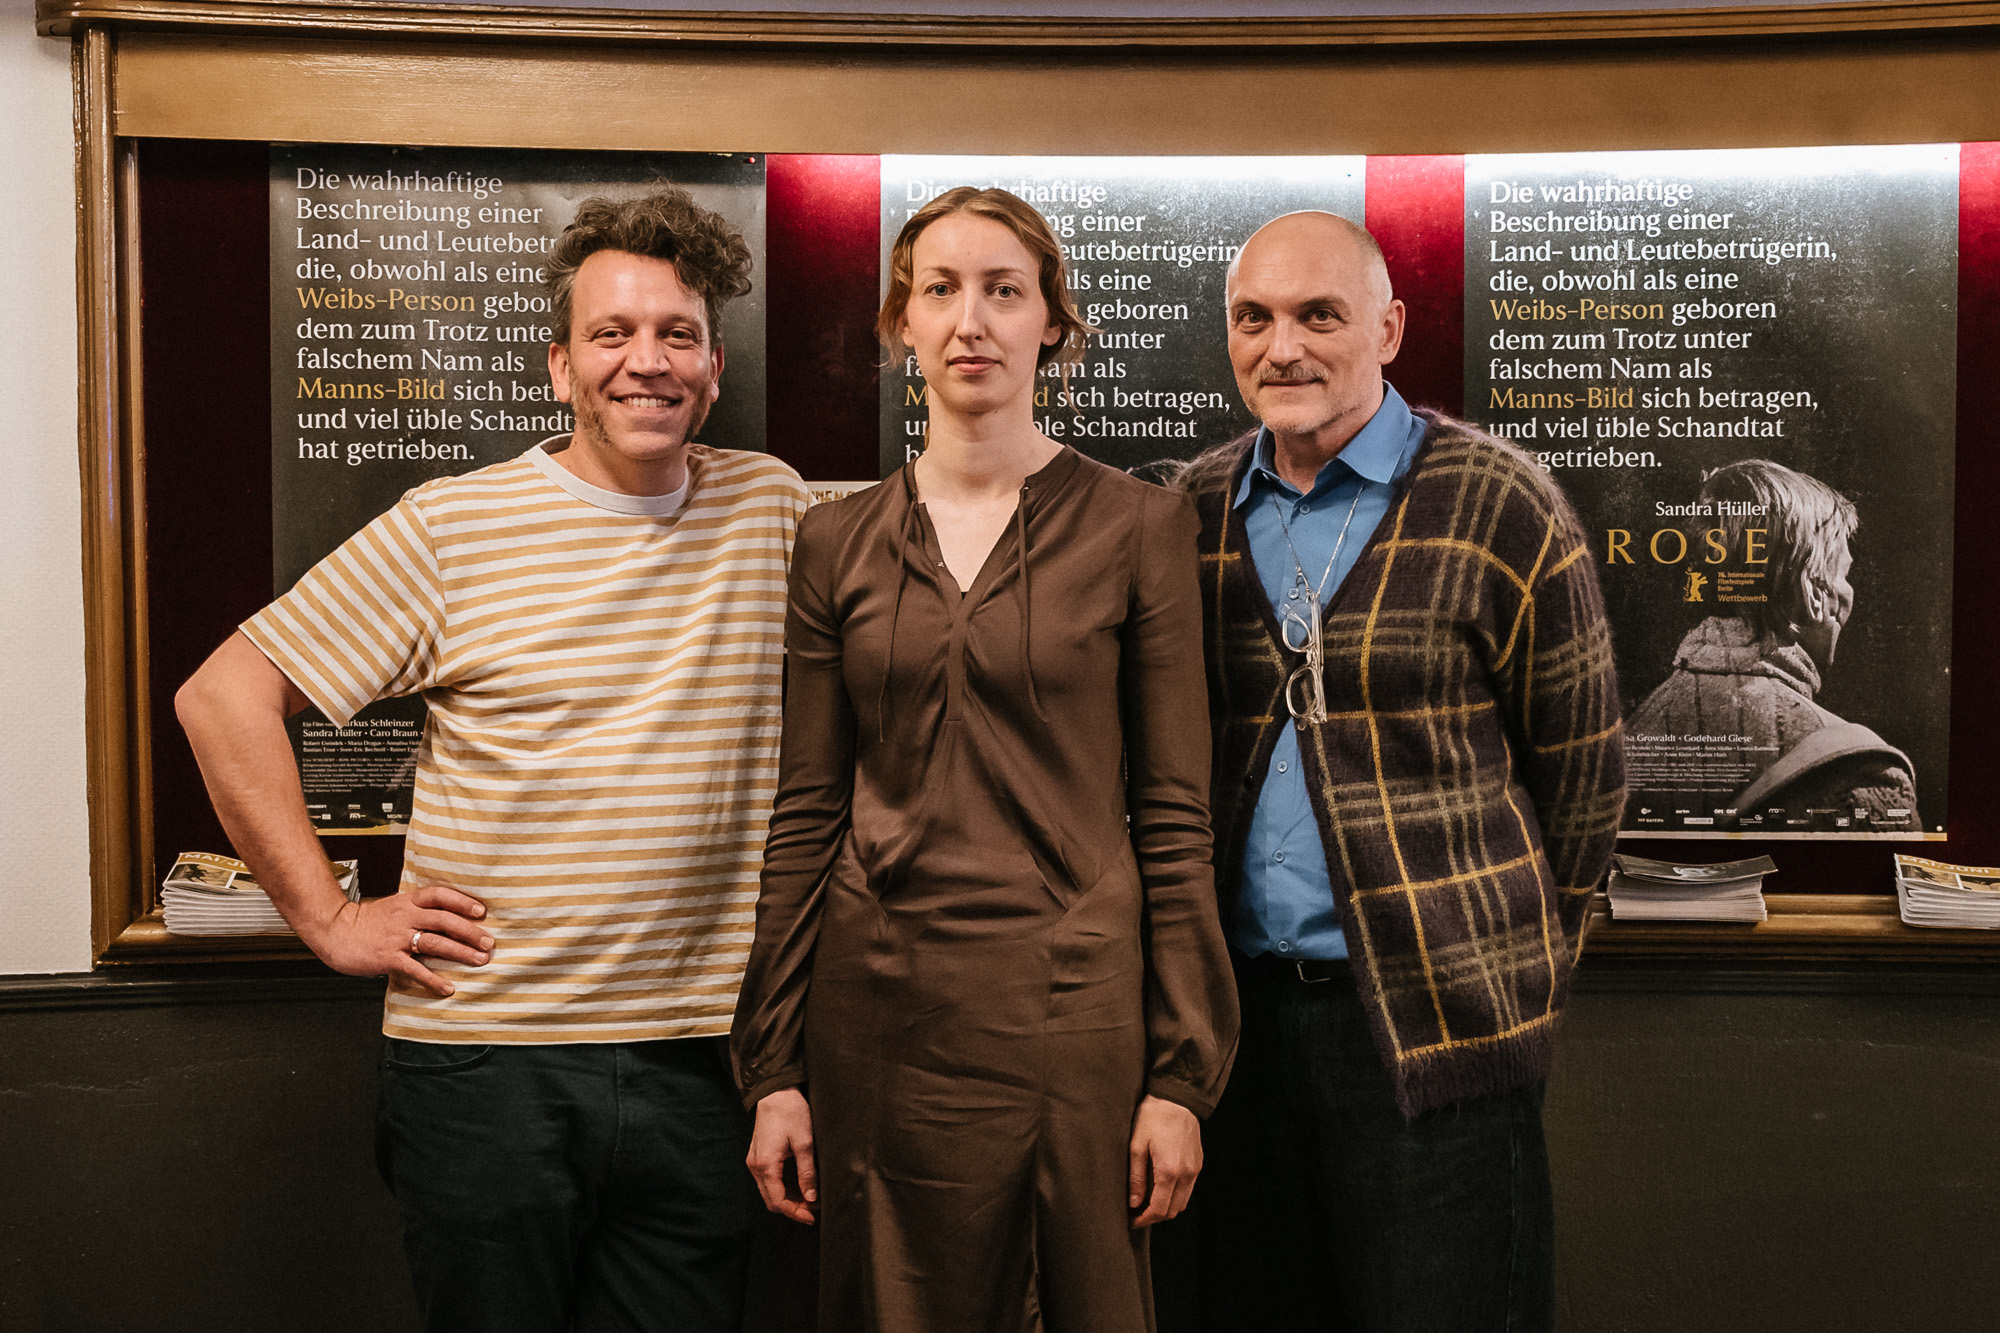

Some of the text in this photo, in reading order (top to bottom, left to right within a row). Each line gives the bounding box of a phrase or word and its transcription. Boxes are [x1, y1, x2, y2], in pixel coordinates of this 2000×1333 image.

[296, 168, 503, 199] Die wahrhaftige
[1490, 182, 1694, 207] Die wahrhaftige
[296, 198, 543, 228] Beschreibung einer
[1082, 211, 1145, 233] einer
[1490, 211, 1733, 237] Beschreibung einer
[296, 228, 558, 254] Land- und Leutebetr
[1490, 238, 1837, 266] Land- und Leutebetrügerin,
[1060, 240, 1238, 267] eutebetrügerin
[296, 259, 342, 284] die,
[350, 261, 445, 283] obwohl
[453, 262, 488, 283] als
[1099, 271, 1151, 291] eine
[1490, 269, 1738, 295] die, obwohl als eine
[297, 289, 476, 312] Weibs-Person
[1490, 298, 1776, 325] Weibs-Person geboren
[1087, 300, 1188, 326] geboren
[297, 319, 552, 344] dem zum Trotz unte
[1099, 331, 1165, 349] unter
[1490, 329, 1751, 351] dem zum Trotz unter
[297, 348, 524, 372] falschem Nam als
[1094, 358, 1126, 378] als
[1490, 358, 1712, 380] falschem Nam als
[297, 378, 445, 401] Manns-Bild
[453, 380, 503, 402] sich
[1057, 387, 1104, 408] sich
[1114, 387, 1230, 414] betragen,
[1490, 387, 1818, 413] Manns-Bild sich betragen,
[298, 408, 576, 432] und viel üble Schandt
[1074, 415, 1198, 438] Schandtat
[1490, 416, 1784, 440] und viel üble Schandtat
[298, 438, 474, 466] hat getrieben.
[1537, 447, 1662, 473] getrieben.
[1655, 501, 1769, 516] Sandra Hüller
[1606, 529, 1769, 564] ROSE
[1718, 594, 1767, 602] Wettbewerb
[303, 729, 418, 737] Sandra Hüller Caro Braun
[371, 719, 414, 727] Schleinzer
[1684, 734, 1726, 742] Godehard
